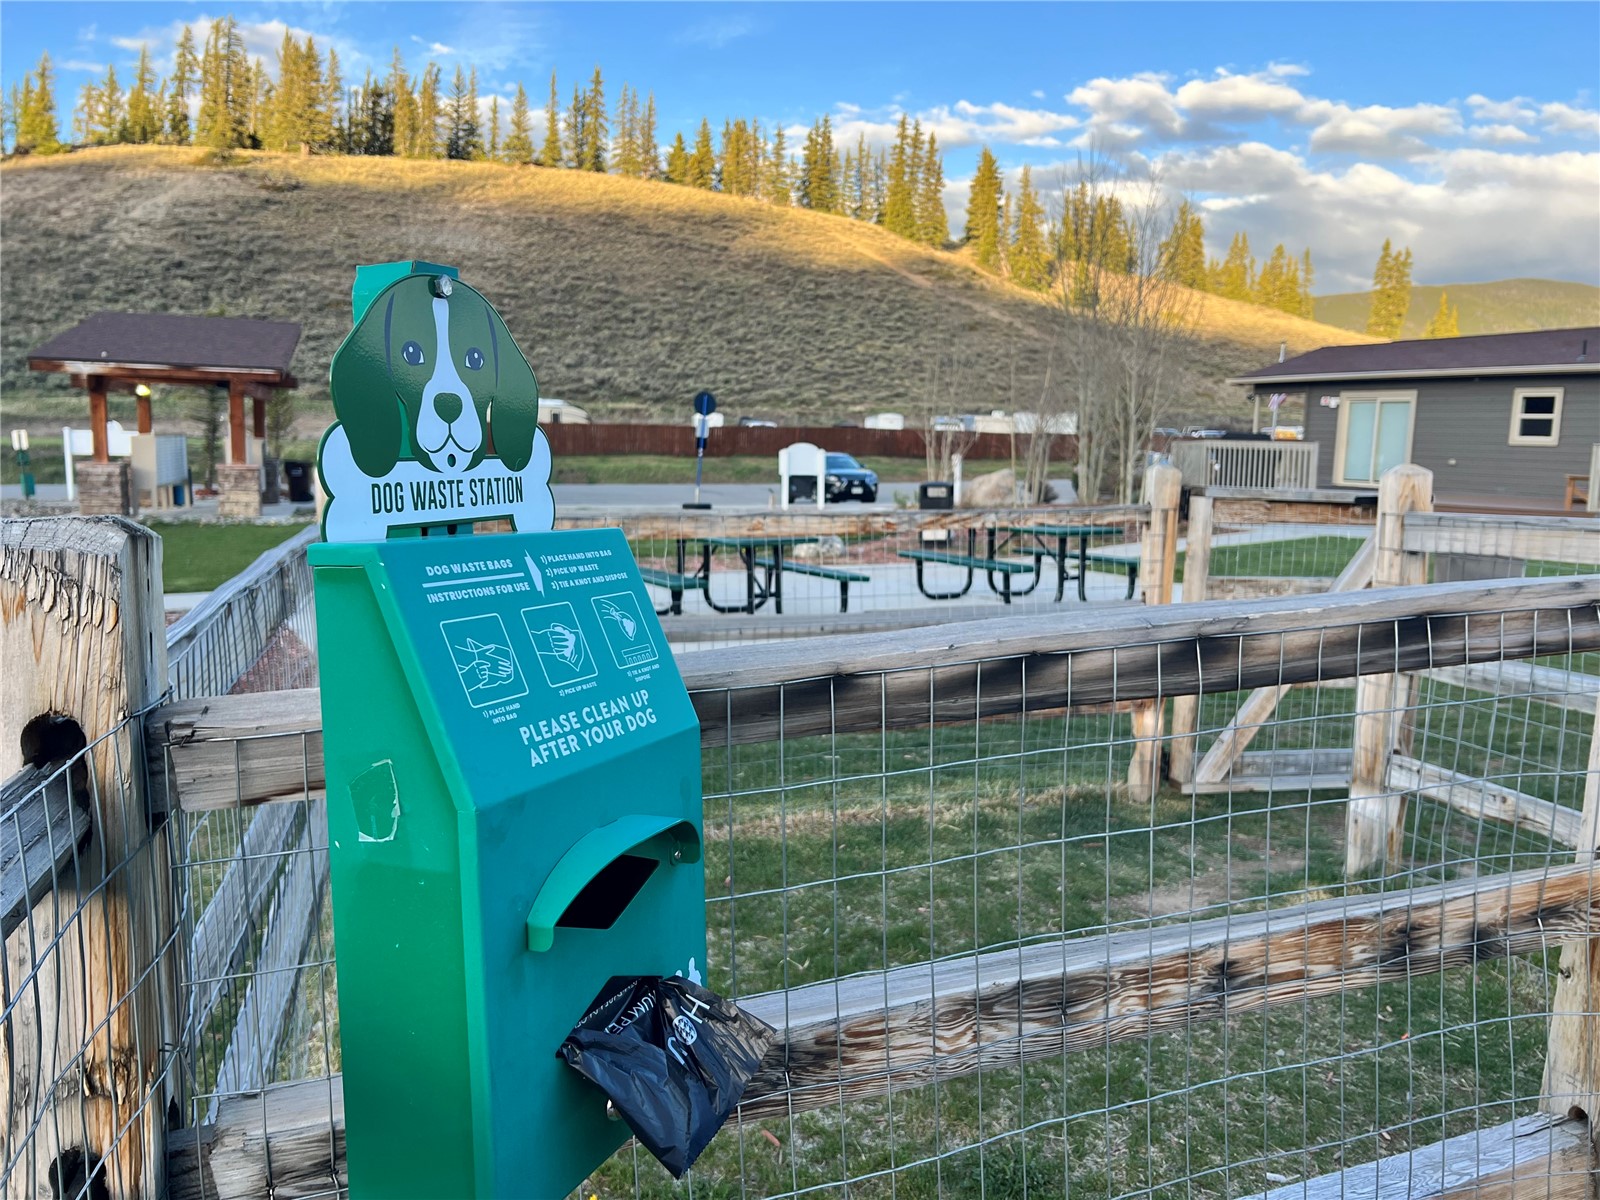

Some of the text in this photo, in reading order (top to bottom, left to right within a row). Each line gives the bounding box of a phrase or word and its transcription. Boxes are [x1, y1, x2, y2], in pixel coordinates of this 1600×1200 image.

[371, 476, 523, 514] DOG WASTE STATION
[547, 554, 568, 563] PLACE
[567, 552, 585, 561] HAND
[585, 551, 600, 559] INTO
[599, 549, 612, 557] BAG
[425, 559, 513, 576] DOG WASTE BAGS
[553, 566, 569, 575] PICK
[569, 565, 577, 574] UP
[577, 563, 599, 572] WASTE
[558, 580, 569, 588] TIE
[570, 579, 575, 587] A
[575, 577, 592, 586] KNOT
[604, 572, 628, 582] DISPOSE
[426, 582, 531, 603] INSTRUCTIONS FOR USE
[519, 689, 649, 745] PLEASE CLEAN UP
[530, 707, 657, 768] AFTER YOUR DOG
